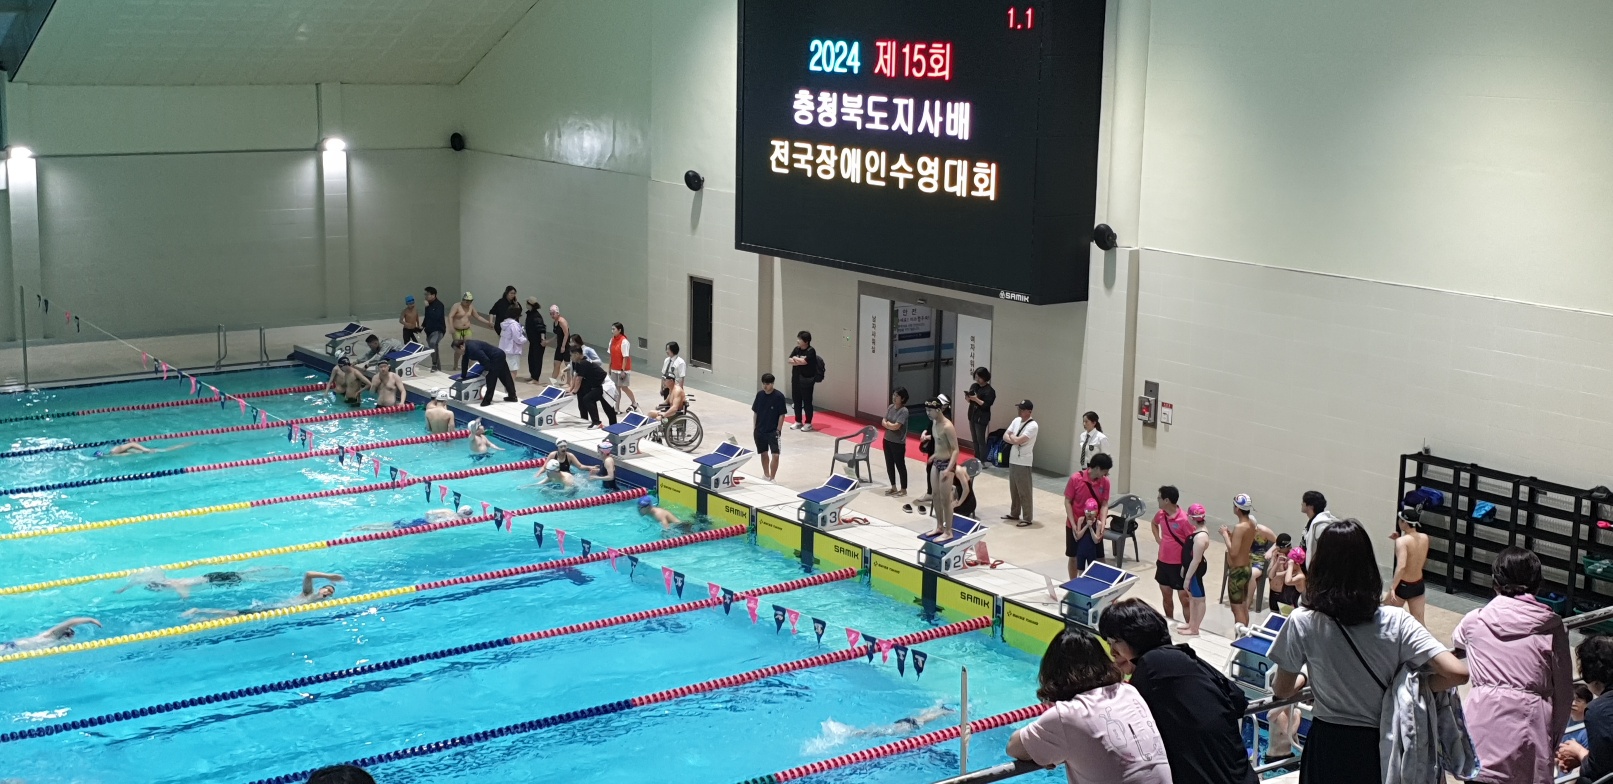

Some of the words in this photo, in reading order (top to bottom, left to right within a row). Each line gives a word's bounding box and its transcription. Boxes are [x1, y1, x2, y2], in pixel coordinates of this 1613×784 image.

[1007, 7, 1035, 29] 1.1
[809, 39, 861, 74] 2024
[793, 89, 971, 140] 충청북도지사배
[769, 139, 997, 201] 전국장애인수영대회
[1005, 292, 1030, 303] SAMIK
[344, 345, 352, 355] 9
[405, 366, 412, 376] 8
[472, 389, 479, 399] 7
[545, 414, 553, 425] 6
[628, 442, 636, 454] 5
[722, 475, 730, 486] 4
[724, 505, 747, 519] SAMIK
[829, 511, 837, 524] 3
[833, 544, 860, 560] SAMIK
[953, 555, 961, 568] 2
[960, 591, 990, 609] SAMIK
